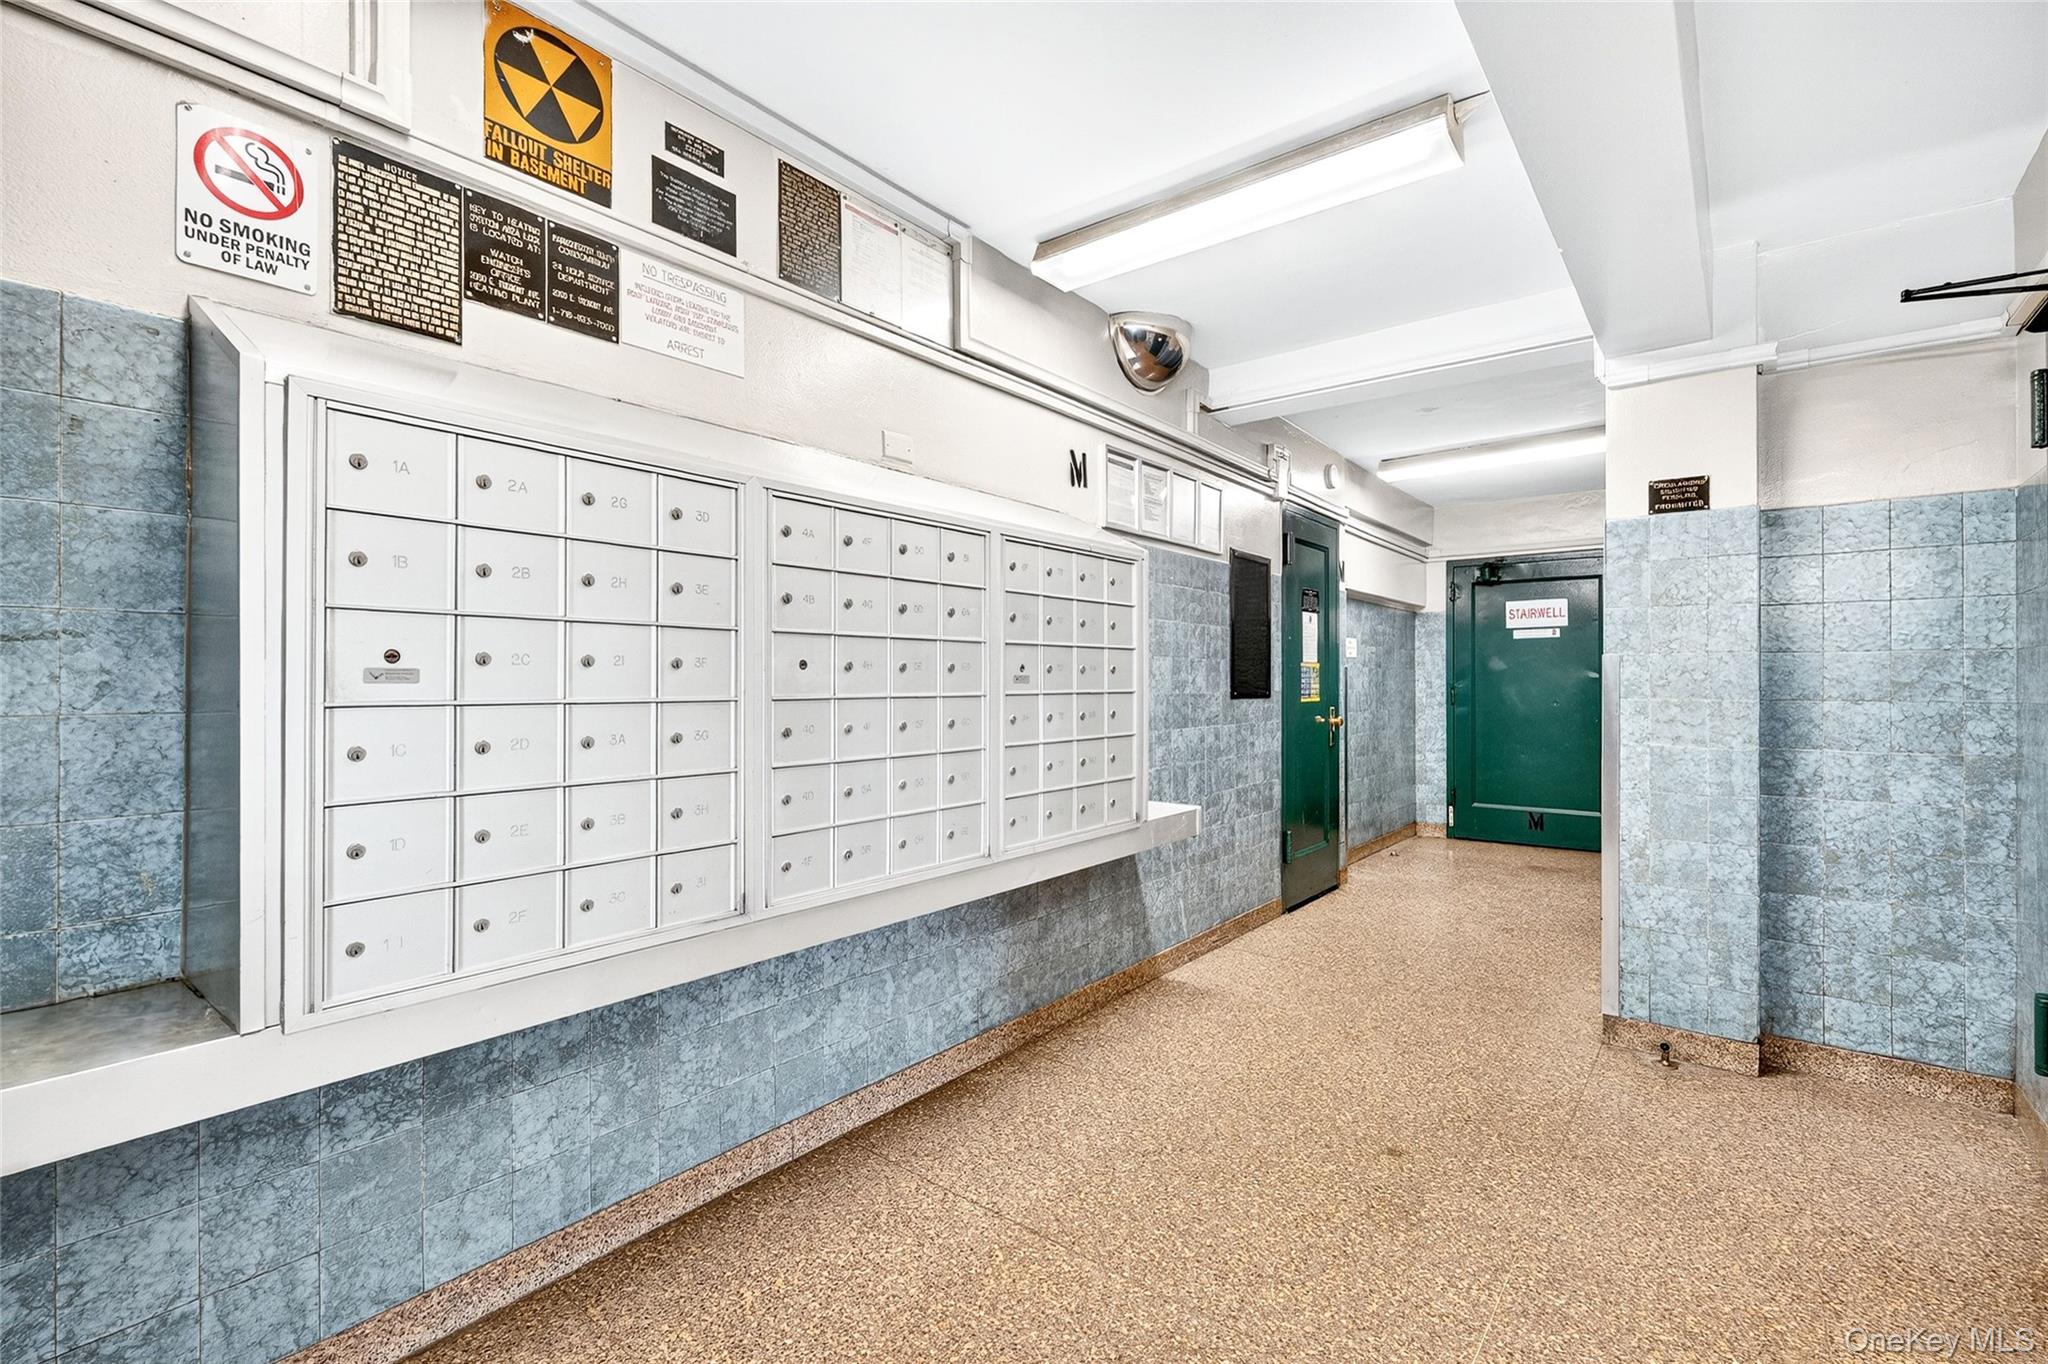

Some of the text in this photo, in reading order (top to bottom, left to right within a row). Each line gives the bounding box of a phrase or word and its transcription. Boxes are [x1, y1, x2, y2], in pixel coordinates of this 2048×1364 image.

[484, 120, 611, 189] FALLOUT SHELTER
[383, 162, 418, 182] NOTICE
[486, 139, 587, 194] IN BASEMENT
[469, 203, 487, 215] KEY
[491, 212, 503, 222] TO
[184, 207, 311, 257] NO SMOKING
[482, 227, 524, 248] LOCATED
[184, 225, 310, 271] UNDER PENALTY
[221, 250, 278, 276] OF LAW
[489, 248, 524, 266] WATCH
[641, 262, 727, 304] NO TRESPASSING
[511, 293, 541, 309] PLANT
[667, 339, 705, 359] ARREST
[392, 459, 411, 476] 1A
[507, 478, 528, 494] 2A
[611, 495, 628, 510] 2G
[695, 510, 711, 523] 3D
[391, 554, 409, 569] 1B
[511, 565, 532, 580] 2B
[610, 576, 628, 589] 2H
[694, 583, 709, 596] 3E
[1508, 607, 1566, 620] STAIRWELL
[511, 652, 531, 666] 2C
[693, 656, 708, 669] 3F
[509, 737, 530, 752] 2D
[609, 733, 626, 746] 3A
[389, 743, 408, 758] 1C
[609, 812, 627, 826] 3B
[1528, 811, 1544, 831] M
[509, 823, 529, 838] 2E
[389, 836, 407, 852] 1D
[508, 909, 527, 925] 2F
